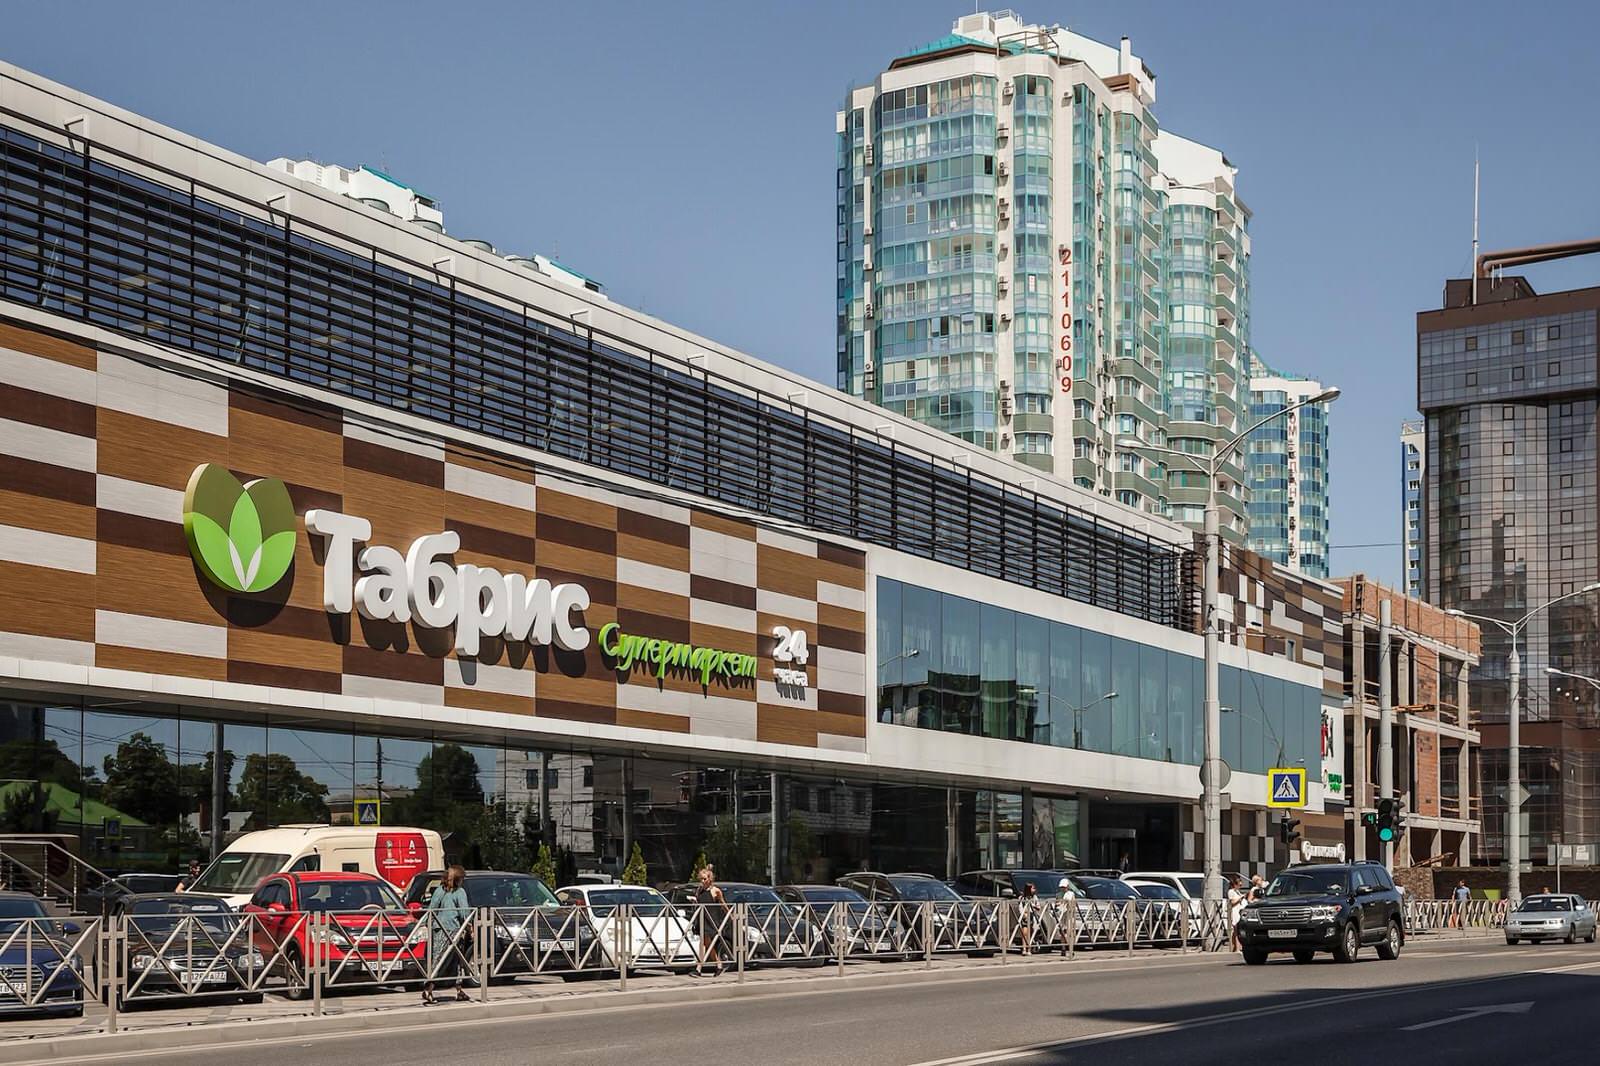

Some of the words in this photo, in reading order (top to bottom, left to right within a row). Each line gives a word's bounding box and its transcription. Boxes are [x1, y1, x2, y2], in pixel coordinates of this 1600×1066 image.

[1060, 248, 1072, 393] 2110609
[304, 508, 590, 656] Табрис
[598, 622, 758, 687] Супермаркет
[772, 625, 809, 665] 24
[772, 667, 809, 687] часа
